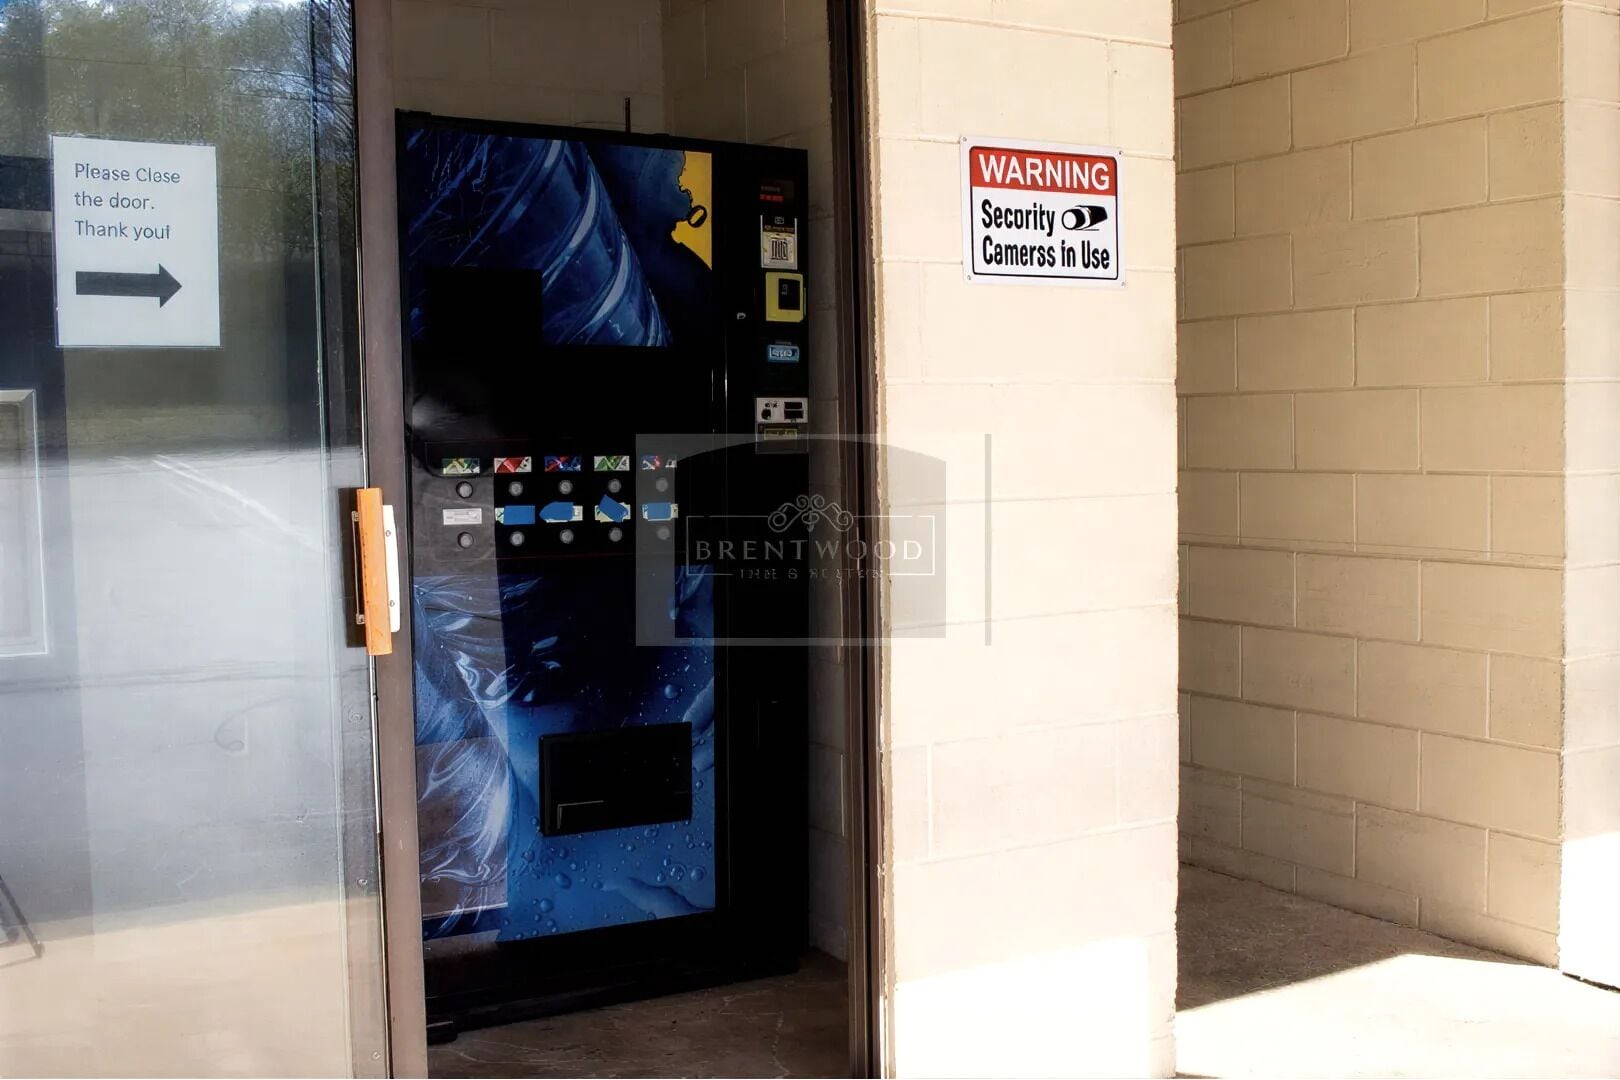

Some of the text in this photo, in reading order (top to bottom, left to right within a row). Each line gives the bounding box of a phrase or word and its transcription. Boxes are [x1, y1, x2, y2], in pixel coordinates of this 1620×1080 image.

[74, 163, 130, 182] Please
[978, 154, 1110, 190] WARNING
[74, 191, 155, 210] the door.
[74, 219, 129, 238] Thank
[1061, 240, 1076, 268] in
[1081, 240, 1110, 270] Use
